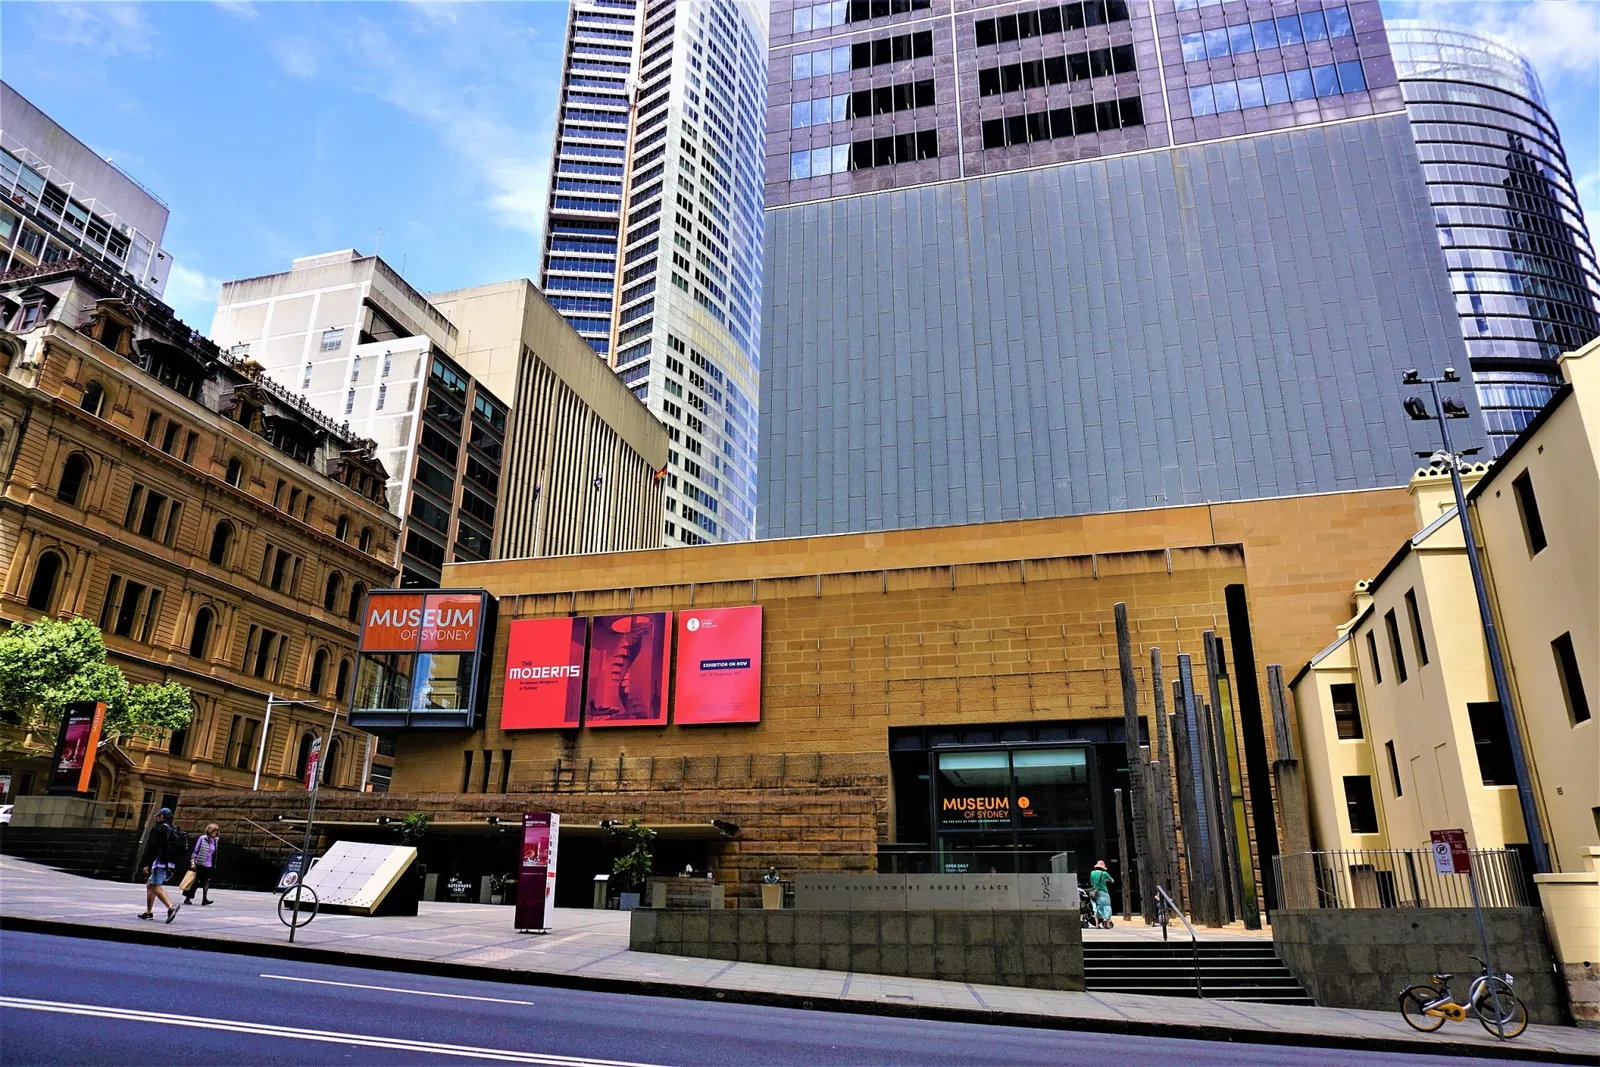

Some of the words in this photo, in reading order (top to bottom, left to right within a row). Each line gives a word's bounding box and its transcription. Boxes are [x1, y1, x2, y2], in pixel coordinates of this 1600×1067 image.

[369, 608, 474, 628] MUSEUM
[400, 629, 418, 641] OF
[421, 629, 471, 641] SYDNEY
[509, 665, 580, 680] MODERNS
[943, 797, 1010, 811] MUSEUM
[964, 811, 976, 819] OF
[977, 810, 1009, 819] SYDNEY
